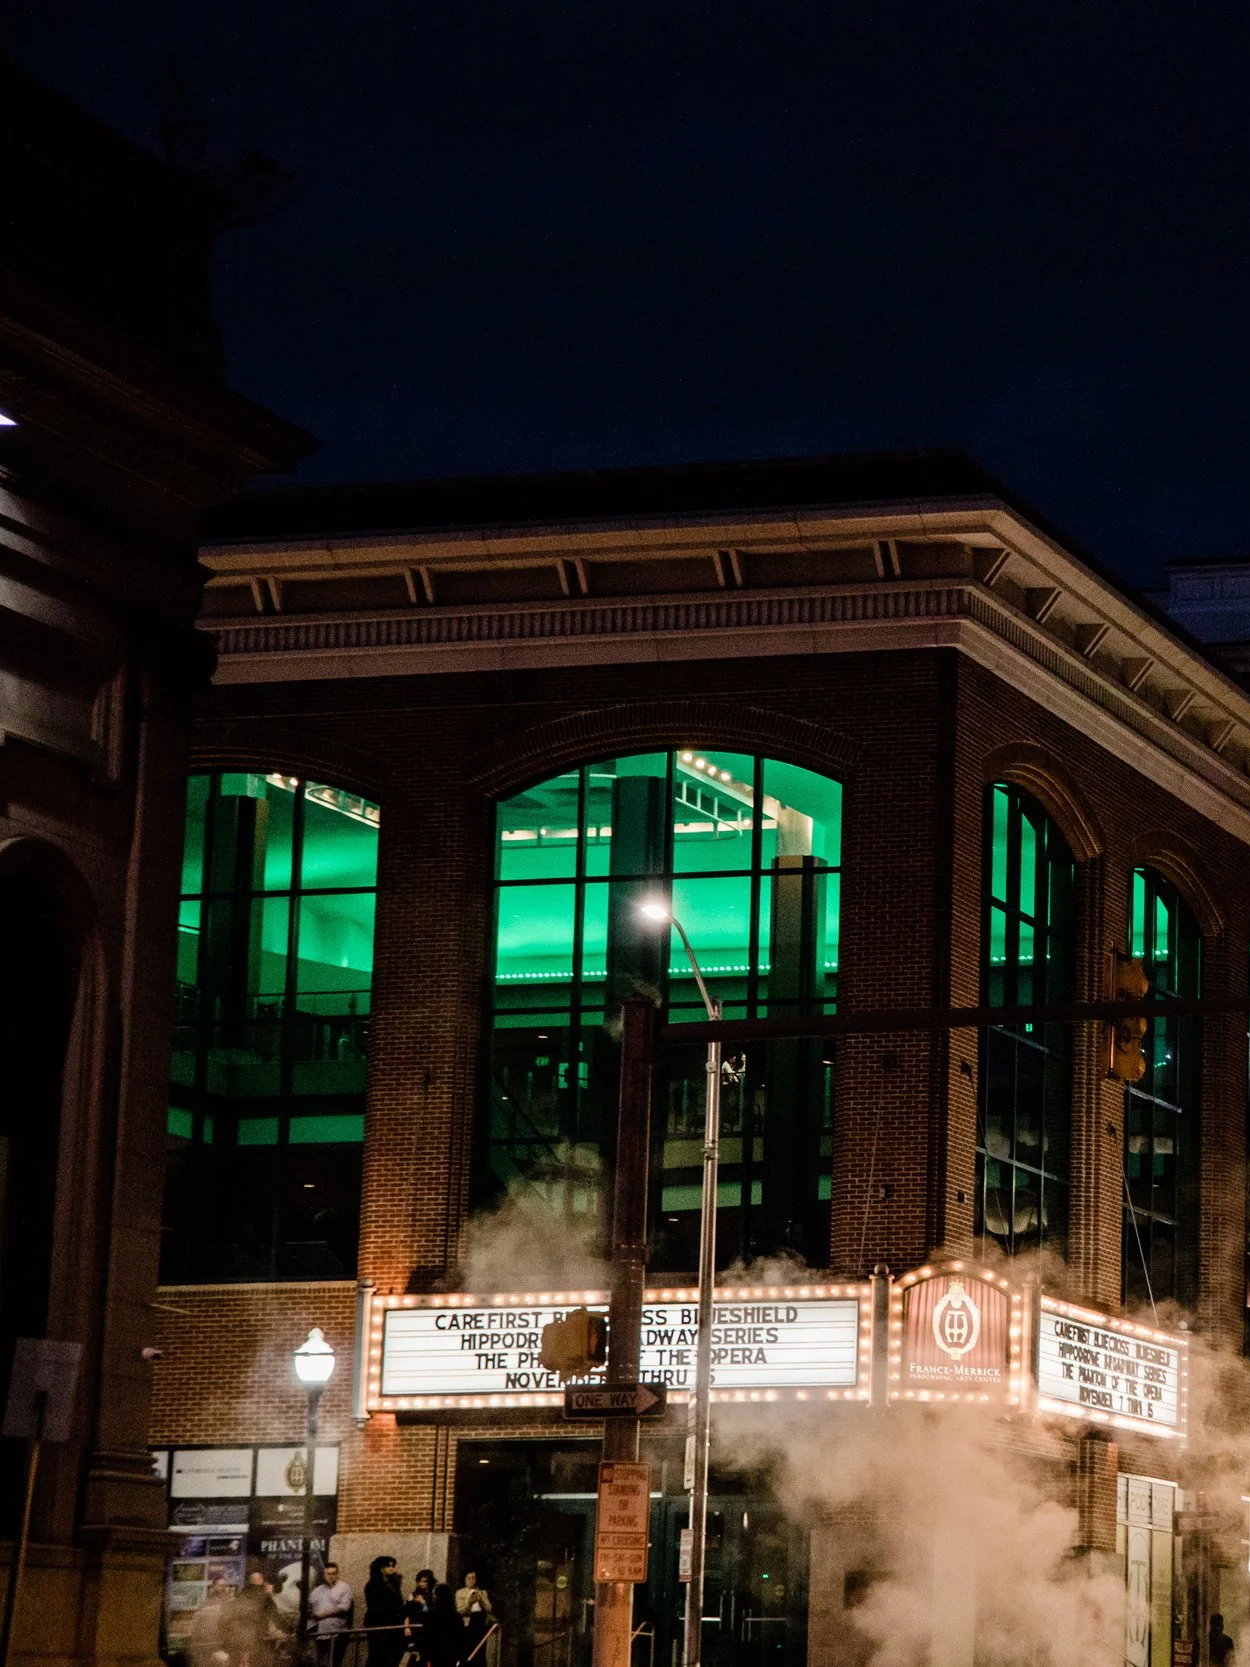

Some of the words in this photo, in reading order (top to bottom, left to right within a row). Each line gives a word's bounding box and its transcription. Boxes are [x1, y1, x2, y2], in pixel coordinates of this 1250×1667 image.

[435, 1312, 542, 1331] CAREFIRST
[461, 1331, 542, 1351] HIPPODR
[711, 1327, 779, 1344] SERIES
[475, 1352, 508, 1370] THE
[657, 1349, 691, 1366] THE
[640, 1369, 688, 1386] THRU
[576, 1393, 603, 1407] ONE
[610, 1392, 638, 1406] WAY
